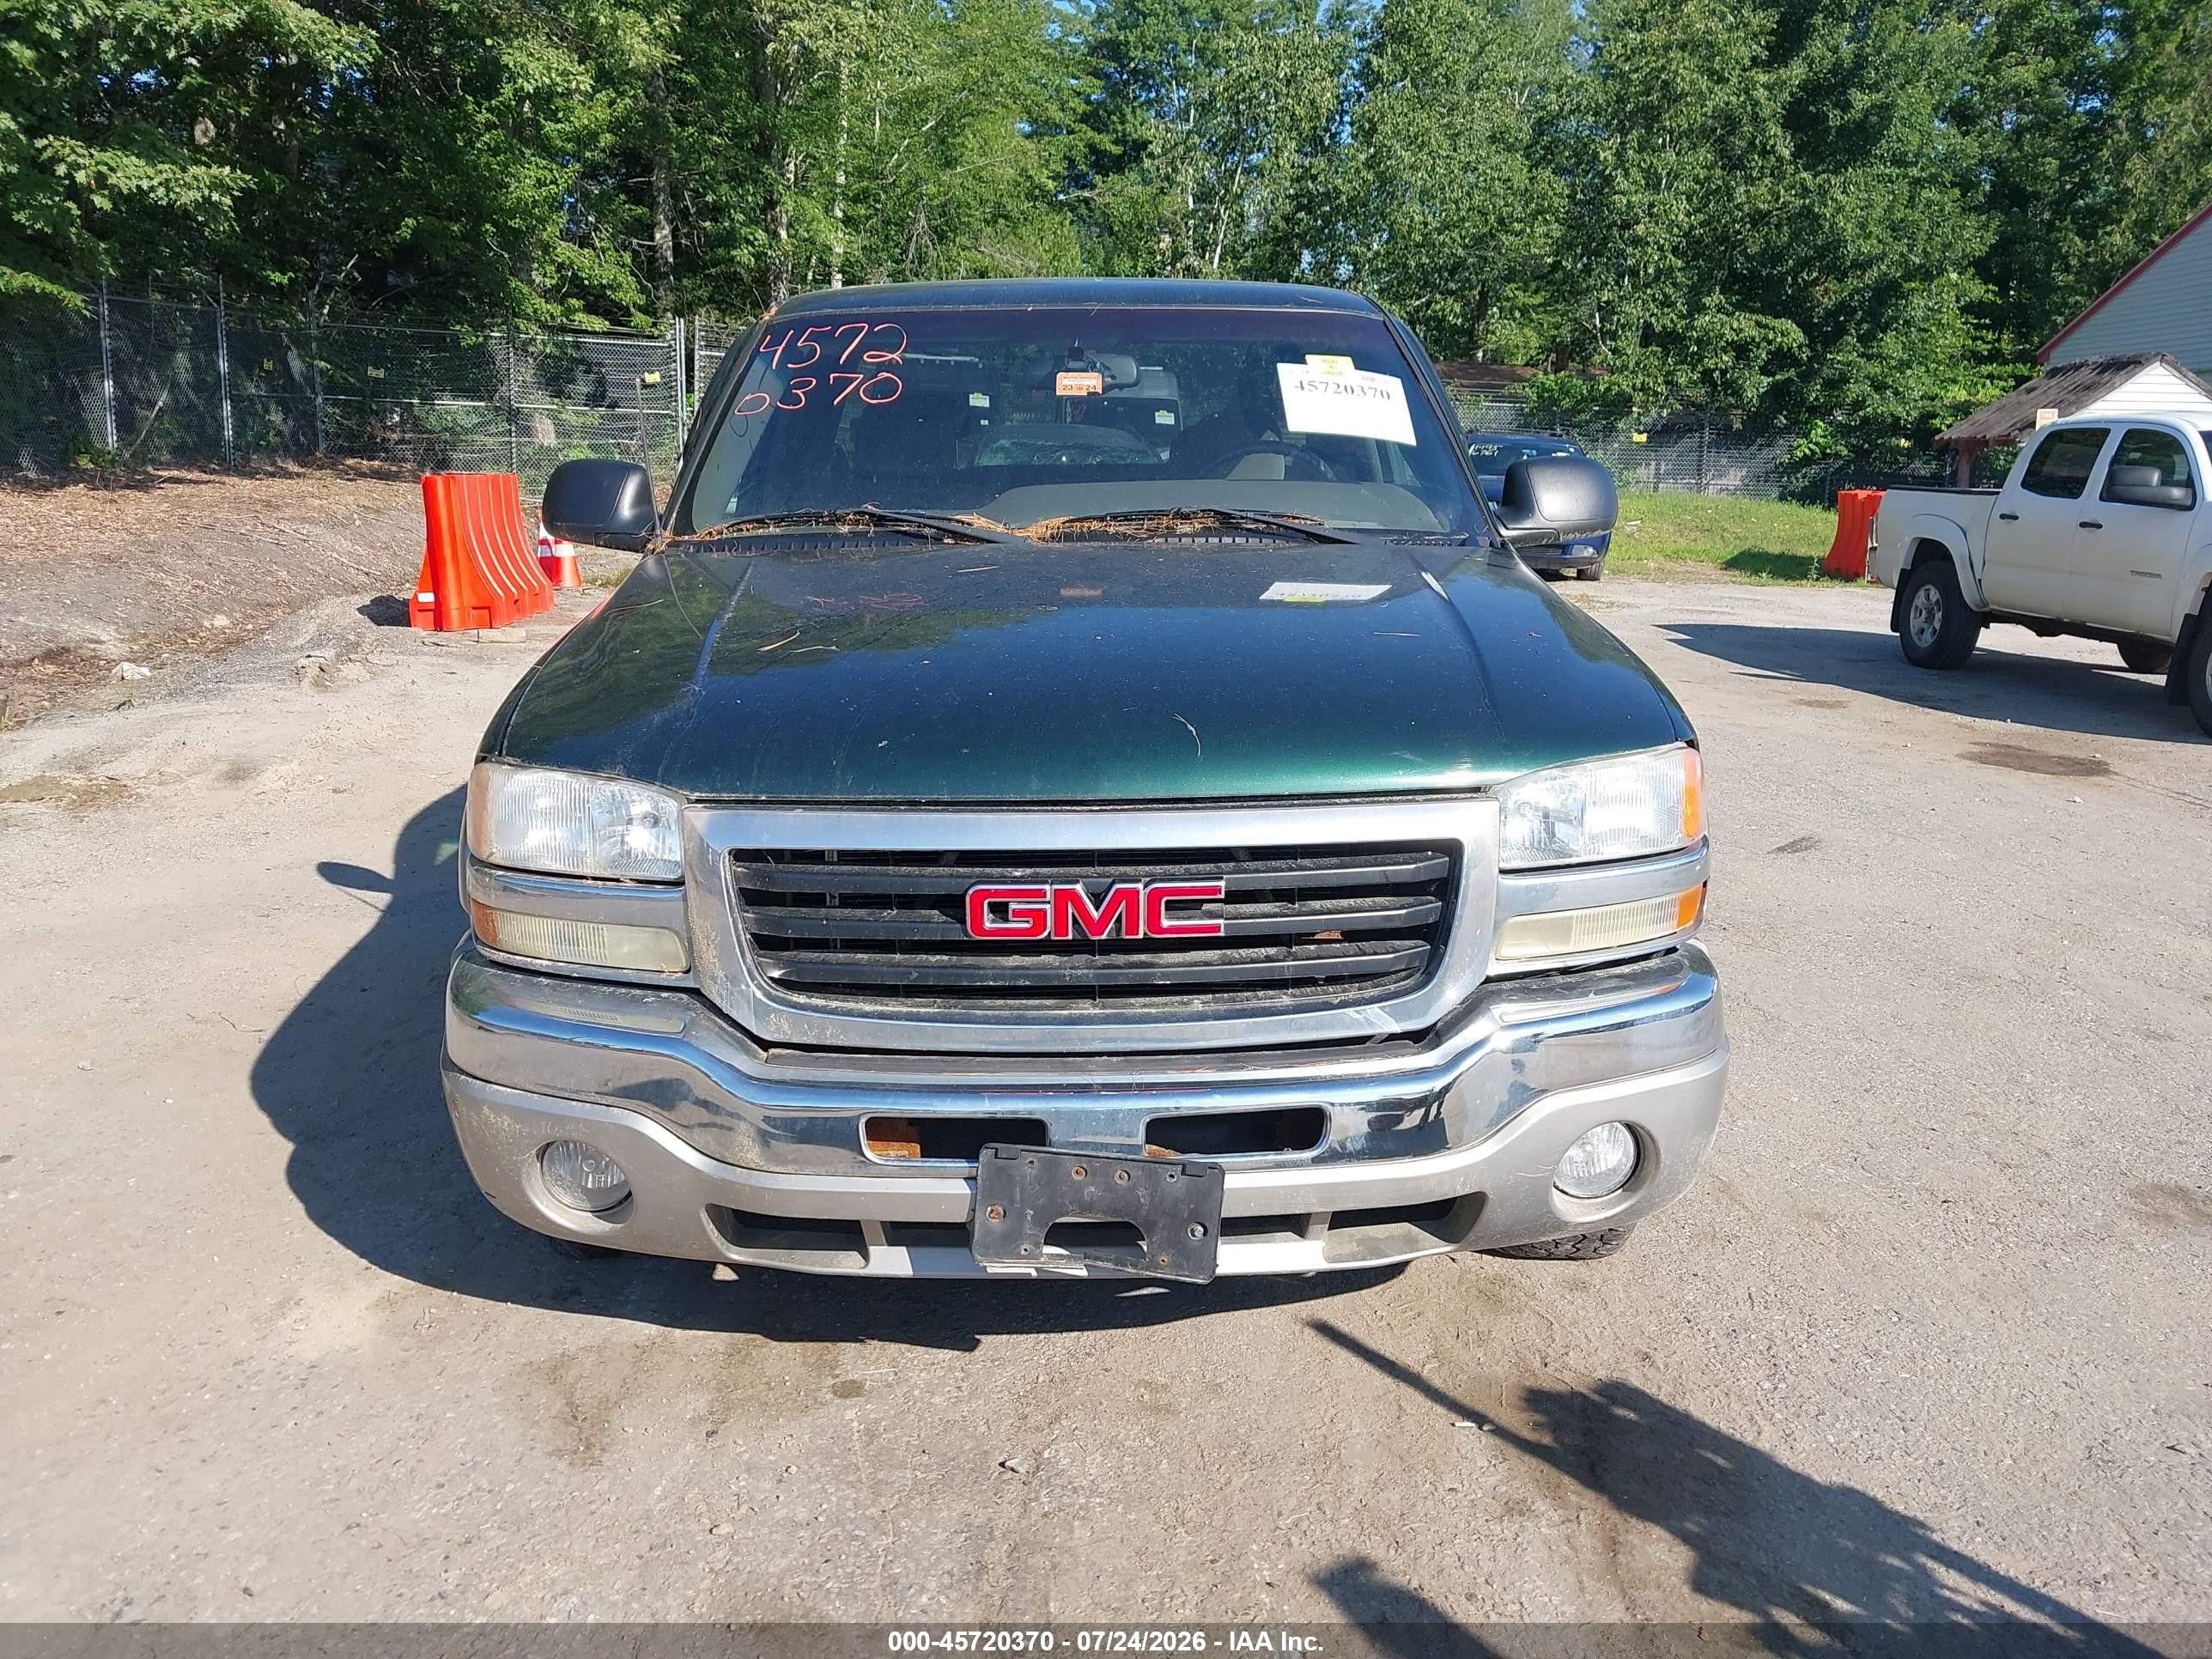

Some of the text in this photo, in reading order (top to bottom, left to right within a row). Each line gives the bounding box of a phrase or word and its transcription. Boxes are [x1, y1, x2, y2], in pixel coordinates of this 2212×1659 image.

[759, 323, 908, 370] 4572
[734, 372, 902, 416] 0370
[1294, 380, 1391, 400] 45720370
[965, 878, 1225, 939] GMC
